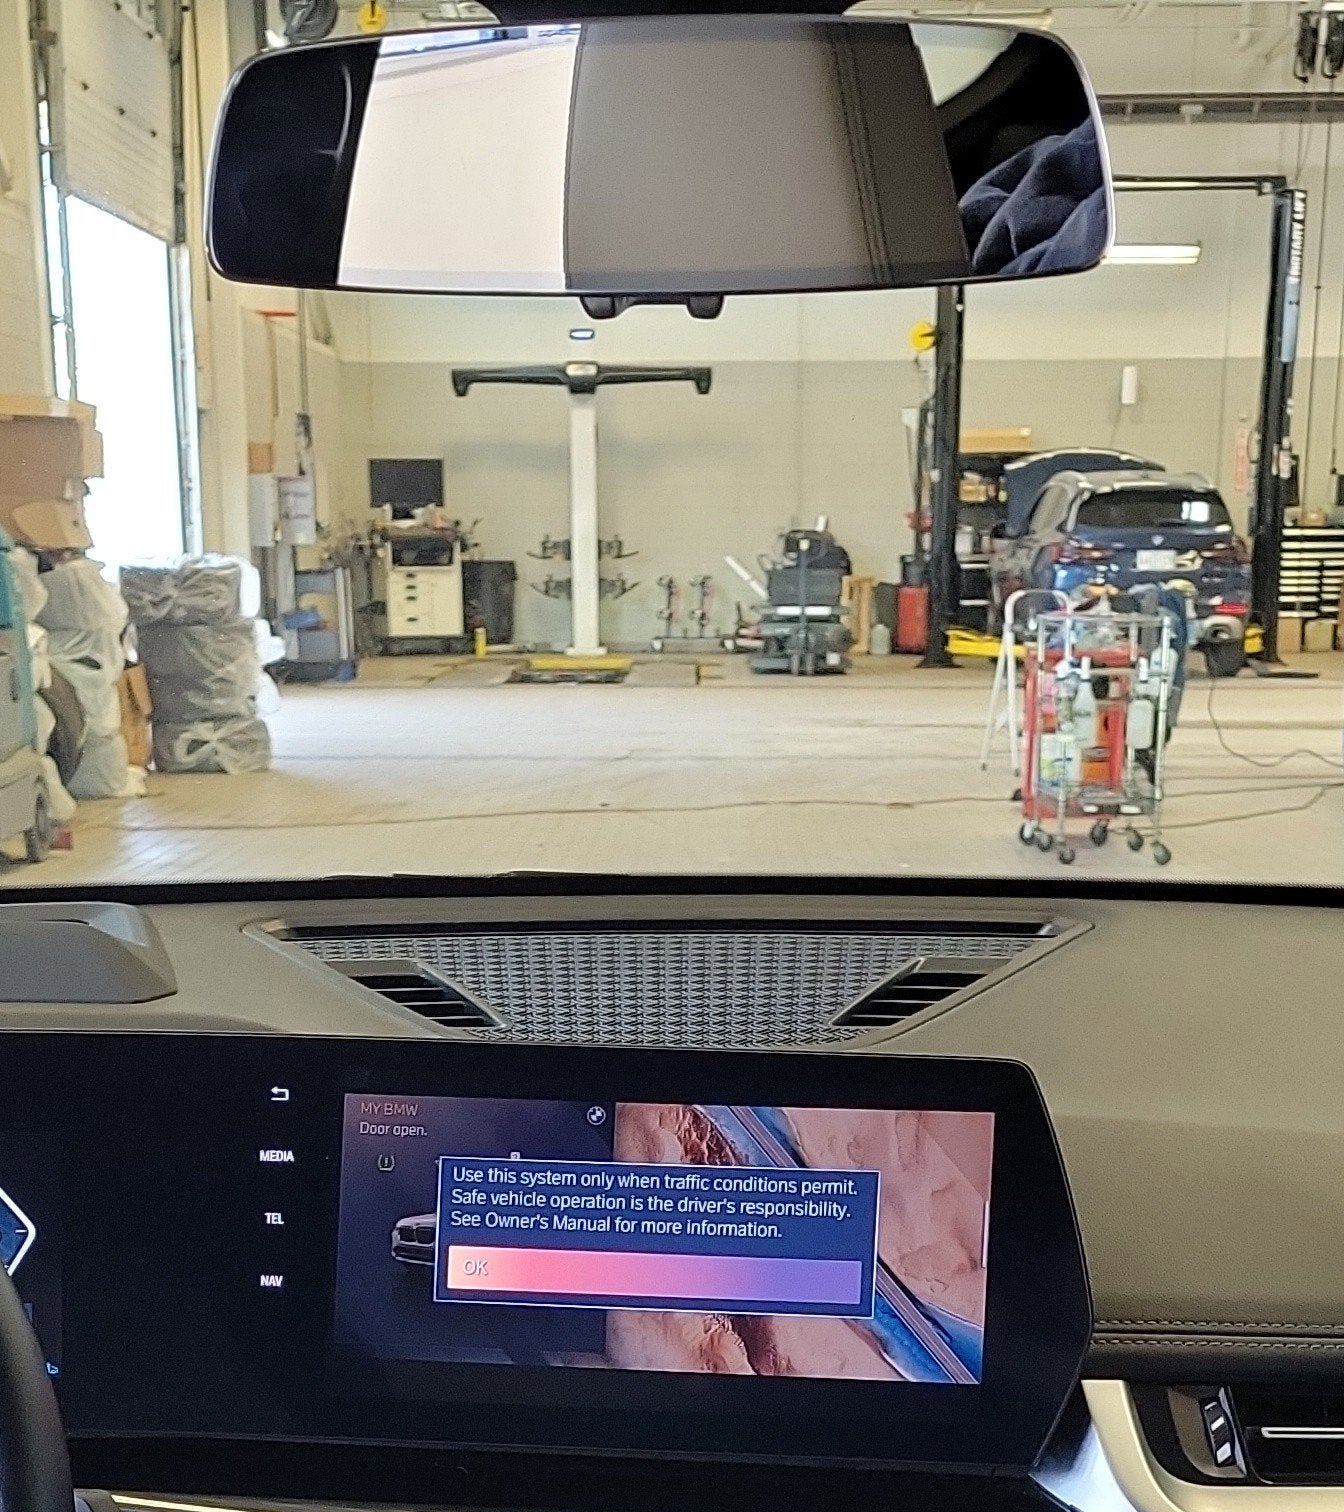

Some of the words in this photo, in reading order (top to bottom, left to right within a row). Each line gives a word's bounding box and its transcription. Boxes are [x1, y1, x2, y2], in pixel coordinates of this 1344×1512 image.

[1293, 190, 1306, 220] LIFT
[360, 1102, 381, 1115] MY
[384, 1103, 418, 1117] BMW
[359, 1122, 390, 1136] Door
[393, 1124, 428, 1137] open.
[259, 1150, 294, 1162] MEDIA
[453, 1167, 483, 1183] Use
[487, 1168, 516, 1184] this
[520, 1170, 576, 1187] system
[580, 1172, 614, 1190] only
[617, 1174, 659, 1189] when
[664, 1174, 709, 1190] traffic
[713, 1176, 797, 1193] conditions
[801, 1179, 857, 1197] permit.
[451, 1188, 486, 1206] Safe
[491, 1190, 546, 1207] vehicle
[550, 1193, 626, 1211] operation
[630, 1195, 644, 1210] is
[647, 1196, 673, 1211] the
[677, 1197, 735, 1214] driver's
[740, 1200, 851, 1218] responsibility.
[264, 1212, 284, 1225] TEL
[451, 1211, 480, 1226] See
[485, 1213, 548, 1230] Owner's
[553, 1215, 610, 1232] Manual
[615, 1218, 637, 1233] for
[641, 1221, 681, 1235] more
[686, 1220, 782, 1238] information.
[464, 1260, 488, 1275] OK
[260, 1275, 283, 1287] NAV
